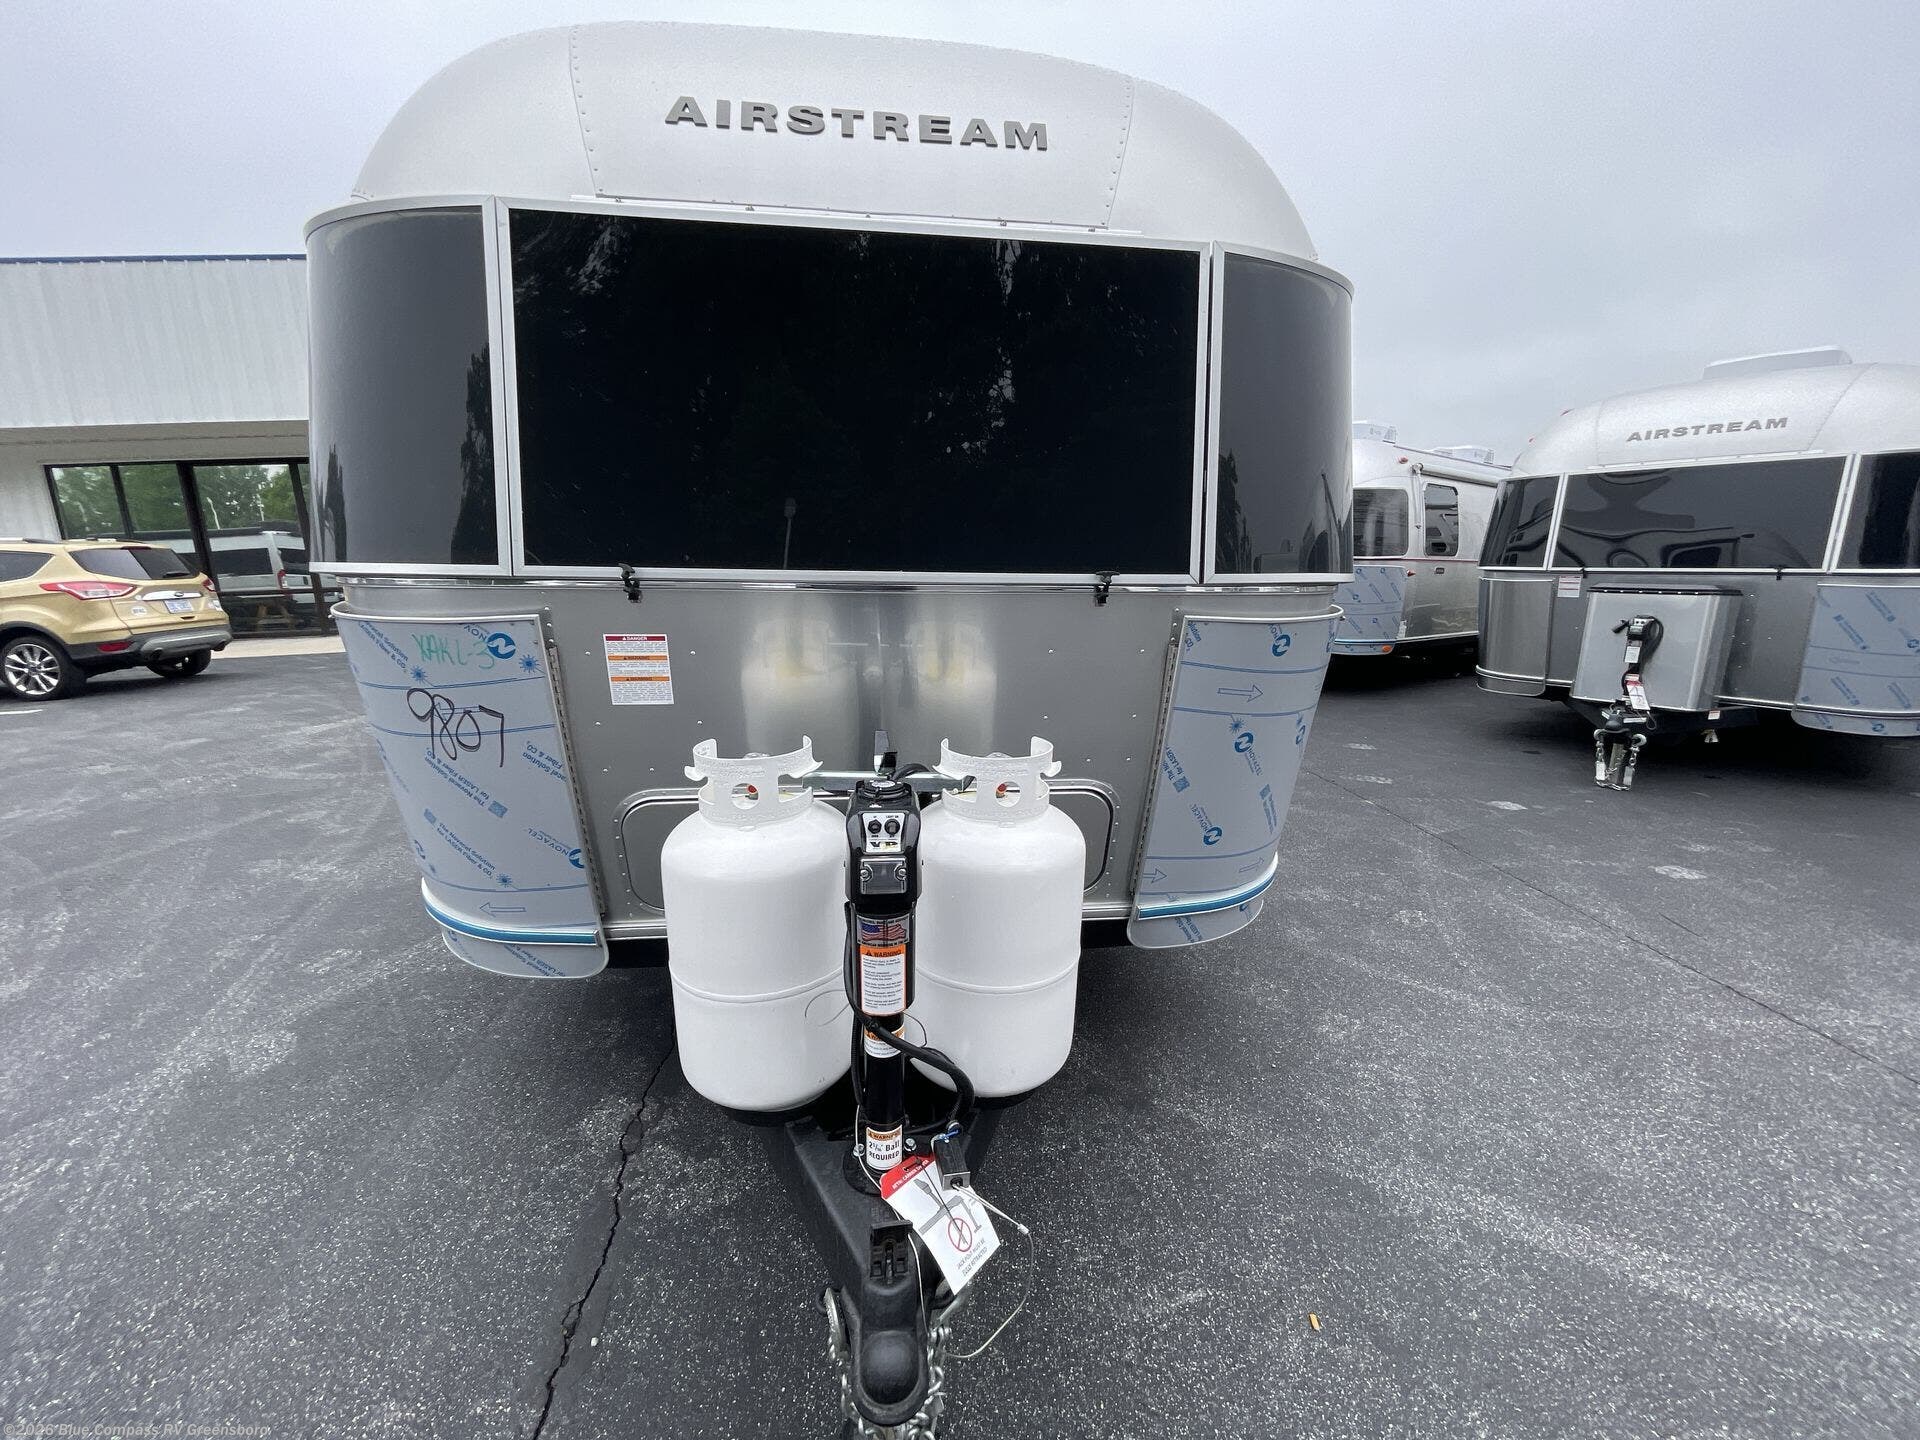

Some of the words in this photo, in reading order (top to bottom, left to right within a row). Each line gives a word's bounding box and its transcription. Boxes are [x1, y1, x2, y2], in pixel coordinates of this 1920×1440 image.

[665, 95, 1048, 151] AIRSTREAM
[1626, 417, 1789, 442] AIRSTREAM
[407, 688, 504, 768] 9807
[522, 752, 551, 773] Solution
[527, 828, 569, 856] NOVACEL
[874, 949, 902, 957] WARNING
[869, 1150, 900, 1160] REQUIRED
[885, 1140, 900, 1151] Ball
